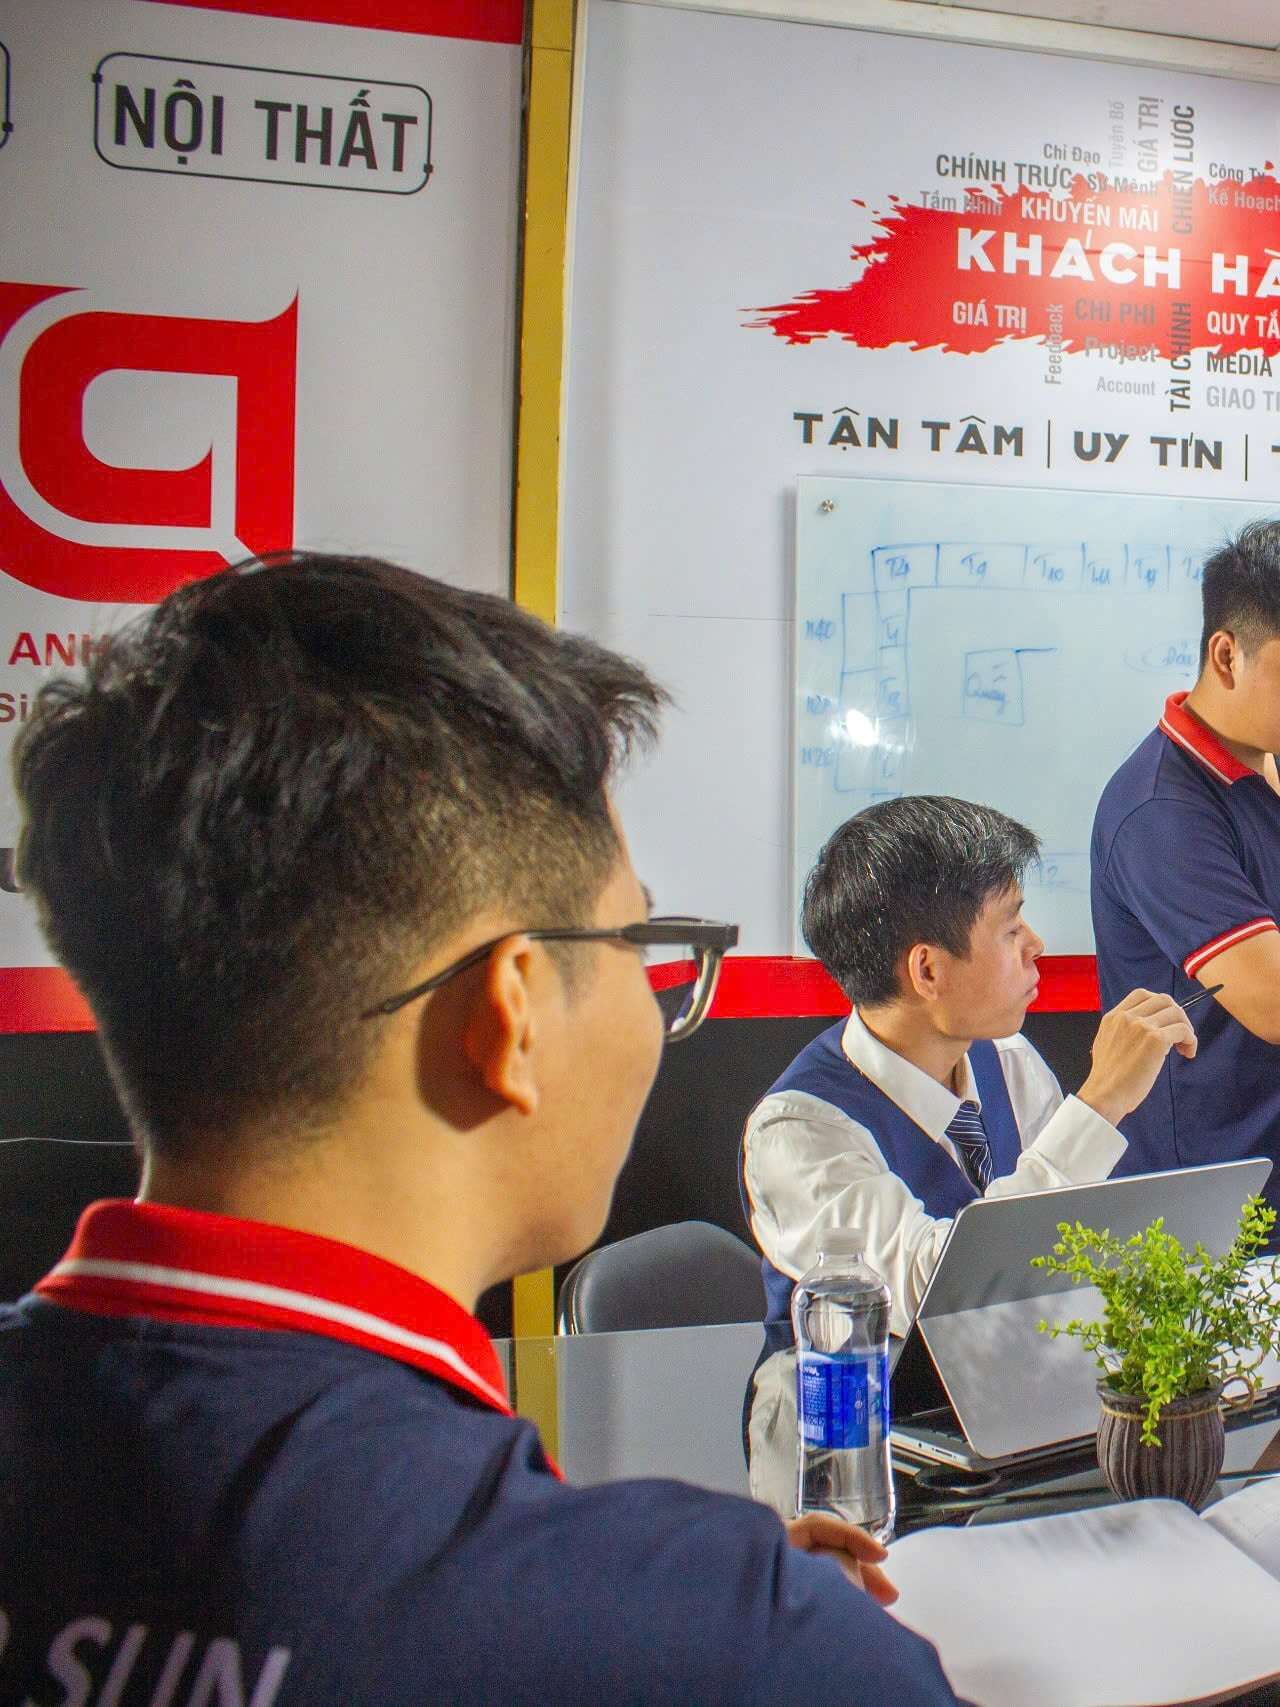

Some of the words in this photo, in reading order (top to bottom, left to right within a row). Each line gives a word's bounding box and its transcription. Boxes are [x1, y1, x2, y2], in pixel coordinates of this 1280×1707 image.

[114, 79, 224, 165] NỘI
[254, 89, 418, 173] THẤT
[936, 152, 1006, 183] CHÍNH
[1014, 161, 1073, 193] TRỰC
[1020, 195, 1111, 227] KHUYẾN
[957, 227, 1181, 289] KHÁCH
[952, 298, 989, 326] GIÁ
[995, 304, 1028, 334] TRỊ
[1206, 311, 1249, 337] QUY
[1085, 336, 1157, 365] Project
[1206, 351, 1273, 378] MEDIA
[1096, 376, 1156, 396] Account
[1165, 382, 1191, 412] TÀI
[1206, 386, 1256, 411] GIAO
[793, 406, 899, 450] TẬN
[921, 415, 1023, 457] TÂM
[1073, 430, 1129, 462] UY
[1150, 432, 1223, 470] TÍN
